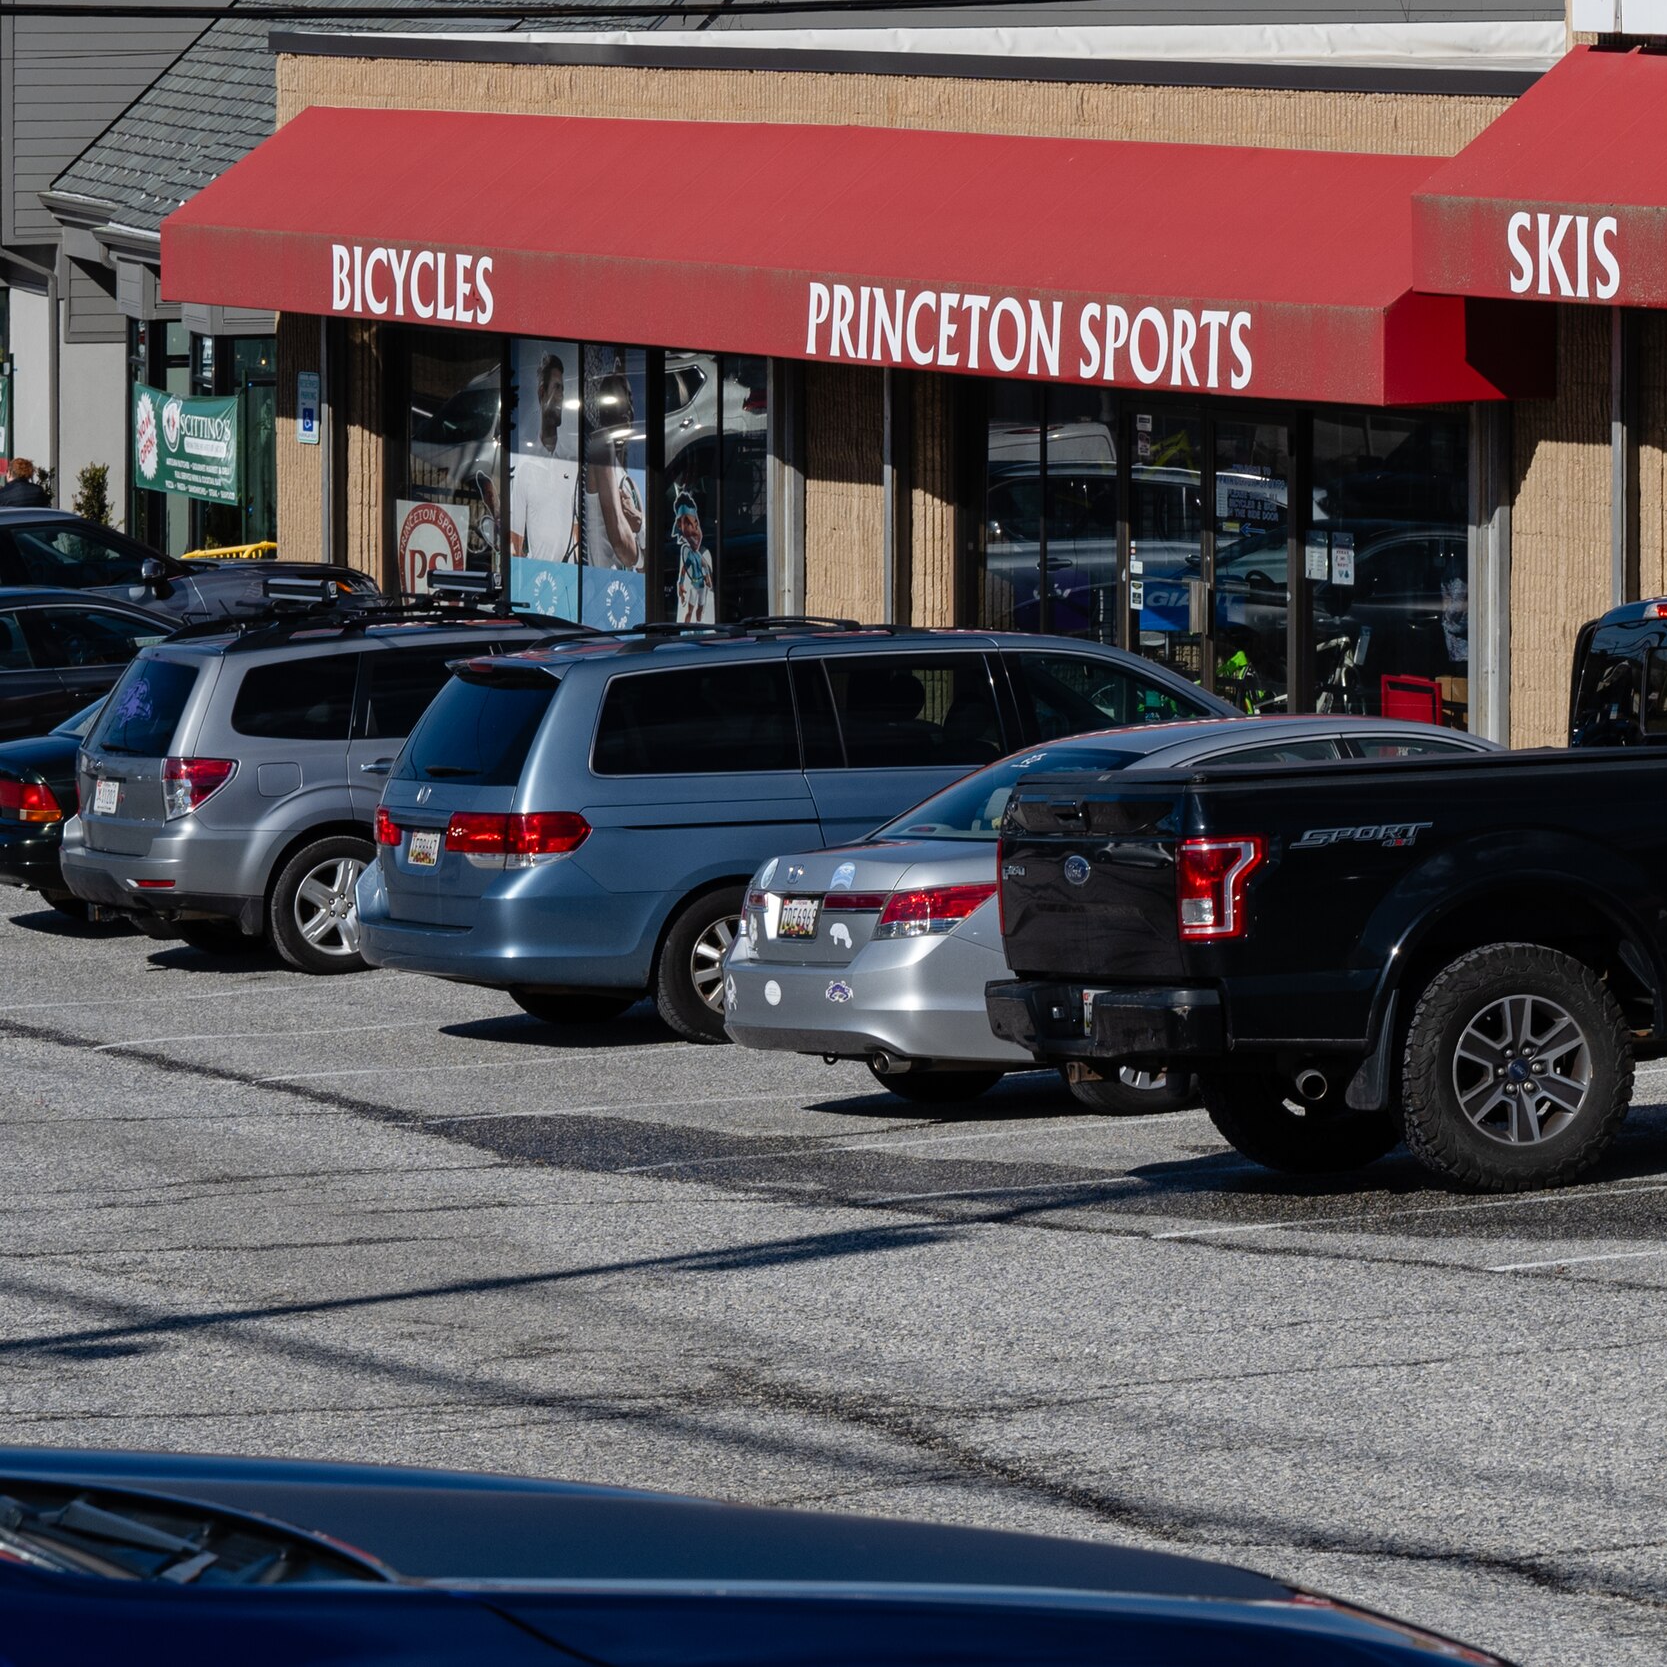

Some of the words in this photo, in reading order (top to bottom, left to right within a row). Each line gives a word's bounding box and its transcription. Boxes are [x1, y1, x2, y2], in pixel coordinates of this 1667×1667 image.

[1508, 212, 1622, 301] SKIS
[332, 244, 495, 326] BICYCLES
[806, 282, 1063, 377] PRINCETON
[1080, 302, 1254, 391] SPORTS
[139, 412, 152, 439] NOW
[180, 413, 231, 441] SCITTINO'S
[400, 508, 437, 555] PRINCETON
[437, 513, 462, 561] SPORTS
[1145, 590, 1236, 608] GIAT
[1289, 821, 1434, 850] SPORT
